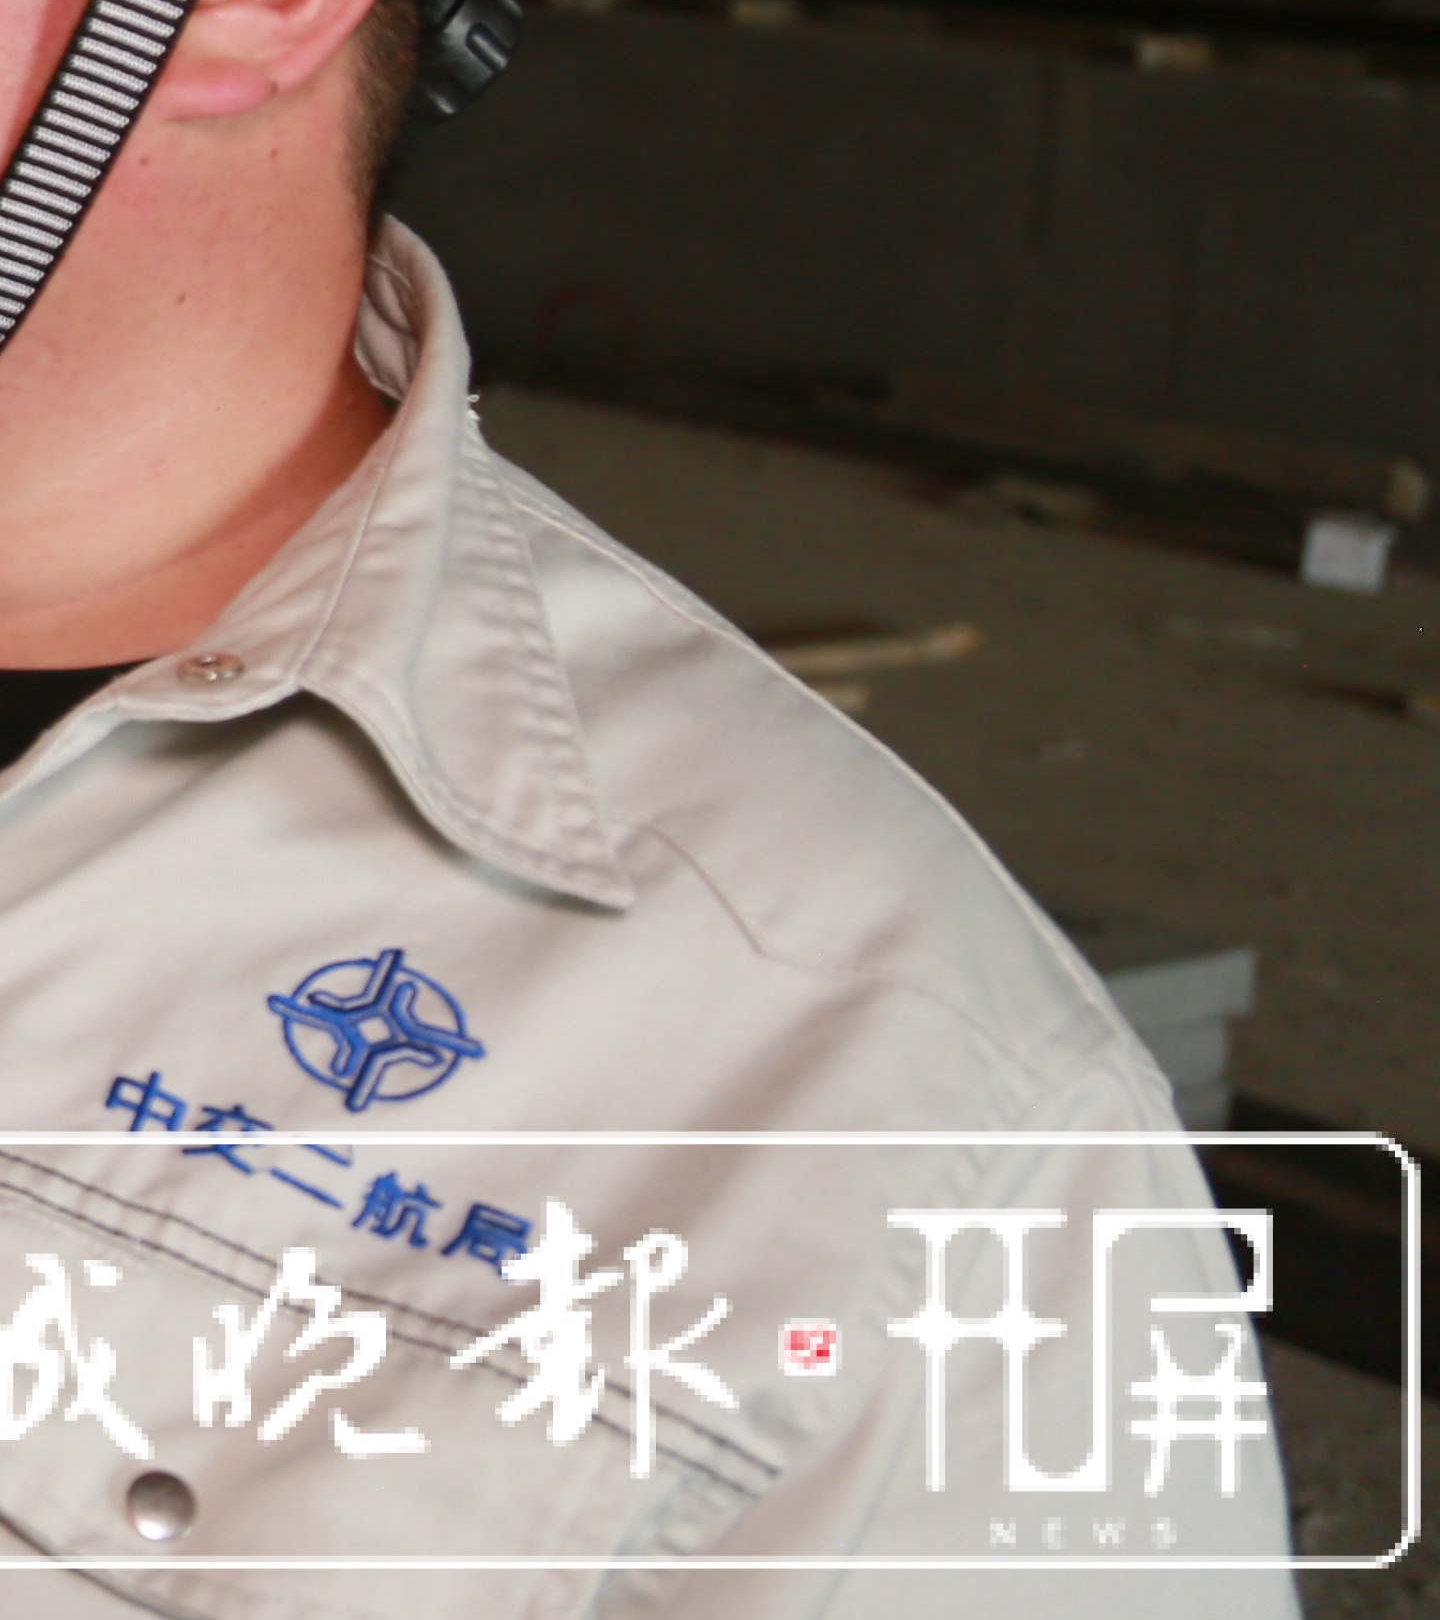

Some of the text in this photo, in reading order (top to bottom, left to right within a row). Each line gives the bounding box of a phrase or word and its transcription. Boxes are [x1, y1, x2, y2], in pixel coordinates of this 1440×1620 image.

[105, 1071, 534, 1279] 中交二航局
